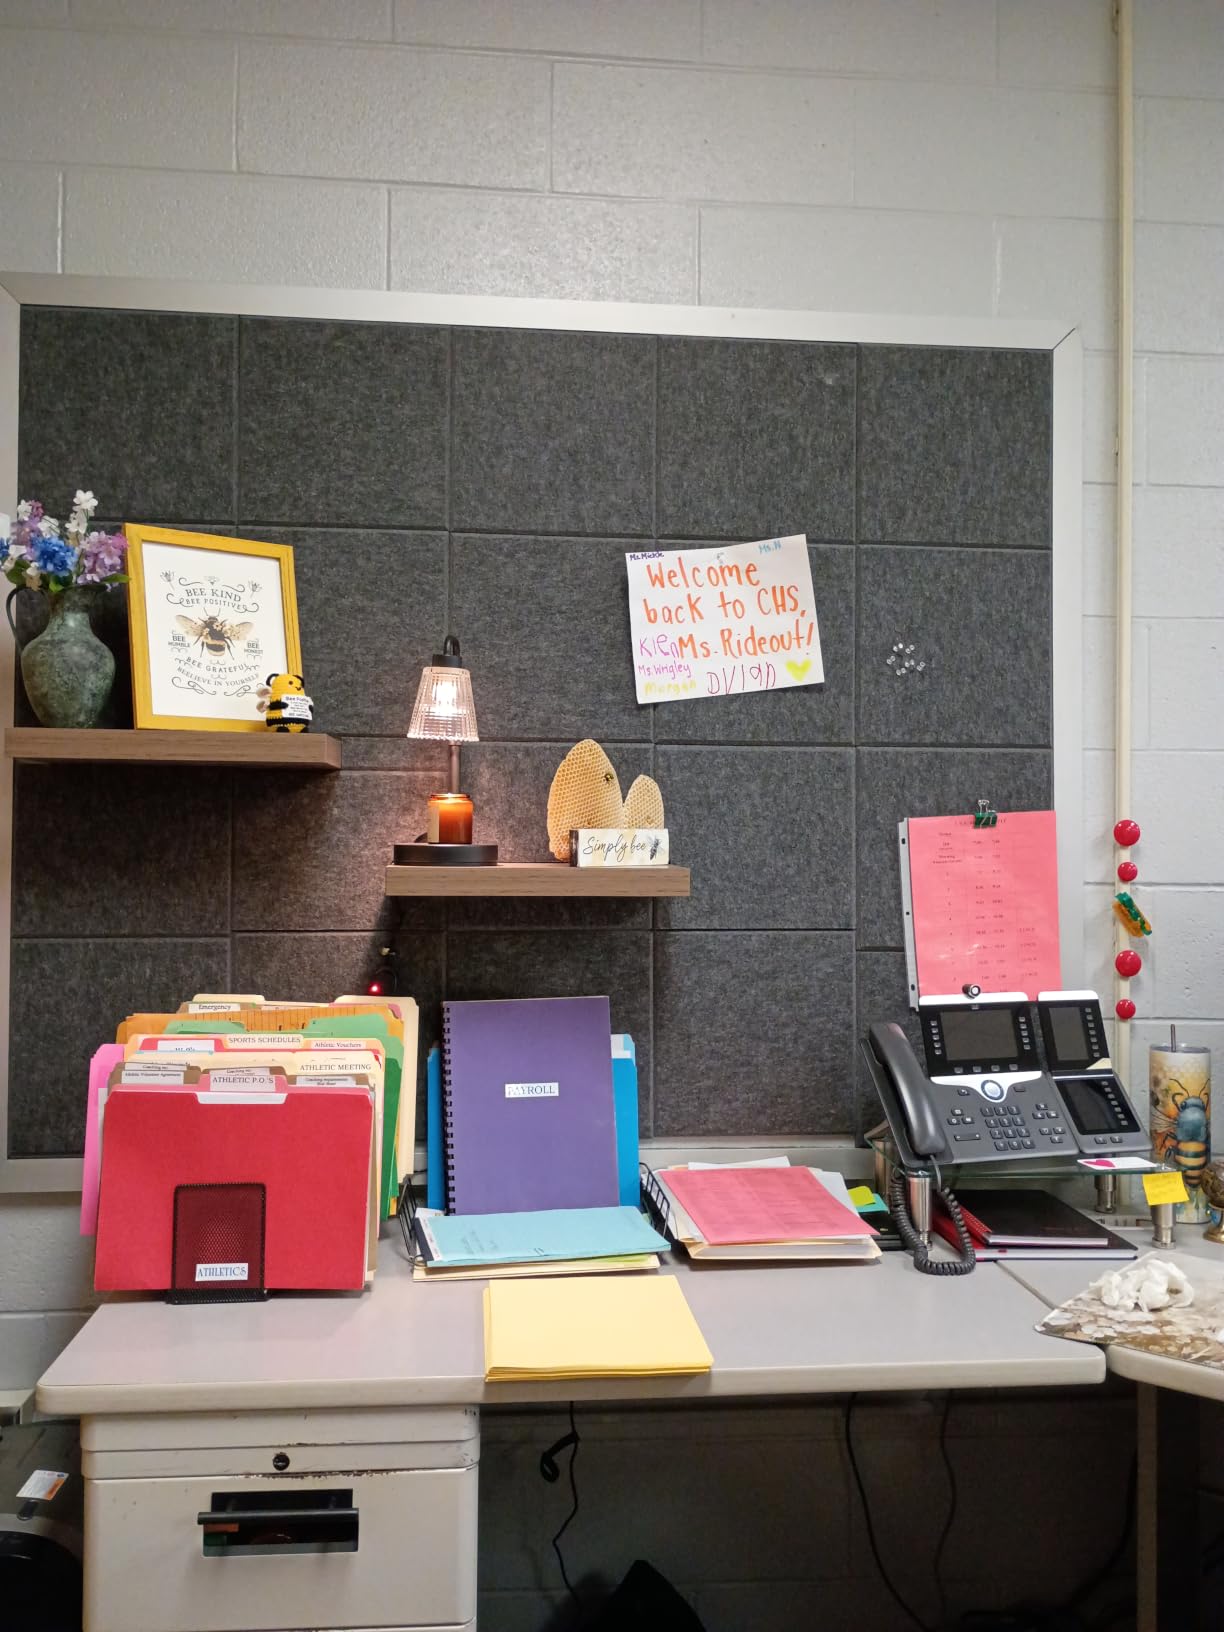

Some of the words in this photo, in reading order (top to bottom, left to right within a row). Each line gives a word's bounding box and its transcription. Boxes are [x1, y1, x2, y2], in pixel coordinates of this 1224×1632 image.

[646, 556, 760, 588] Welcome
[185, 587, 207, 597] BEE
[211, 588, 241, 602] KIND
[204, 598, 247, 611] POSITIVE
[643, 592, 704, 624] back
[717, 591, 745, 619] to
[172, 634, 186, 642] BEE
[678, 633, 719, 659] Ms.
[719, 618, 814, 659] Rideout!
[186, 656, 202, 669] BEE
[205, 663, 249, 674] GRATEFUL
[214, 679, 223, 687] IN
[225, 673, 260, 687] YOURSELF
[582, 833, 630, 863] Simply
[629, 834, 647, 855] bee
[198, 1003, 232, 1011] Emergency
[228, 1037, 256, 1045] SPORTS
[257, 1036, 301, 1045] SCHEDULES
[300, 1063, 337, 1071] ATHLETIC
[337, 1063, 372, 1071] MEETING
[212, 1075, 251, 1084] ATHLETIC
[507, 1084, 556, 1096] PAYROLL
[198, 1266, 247, 1278] ATHLETICS
